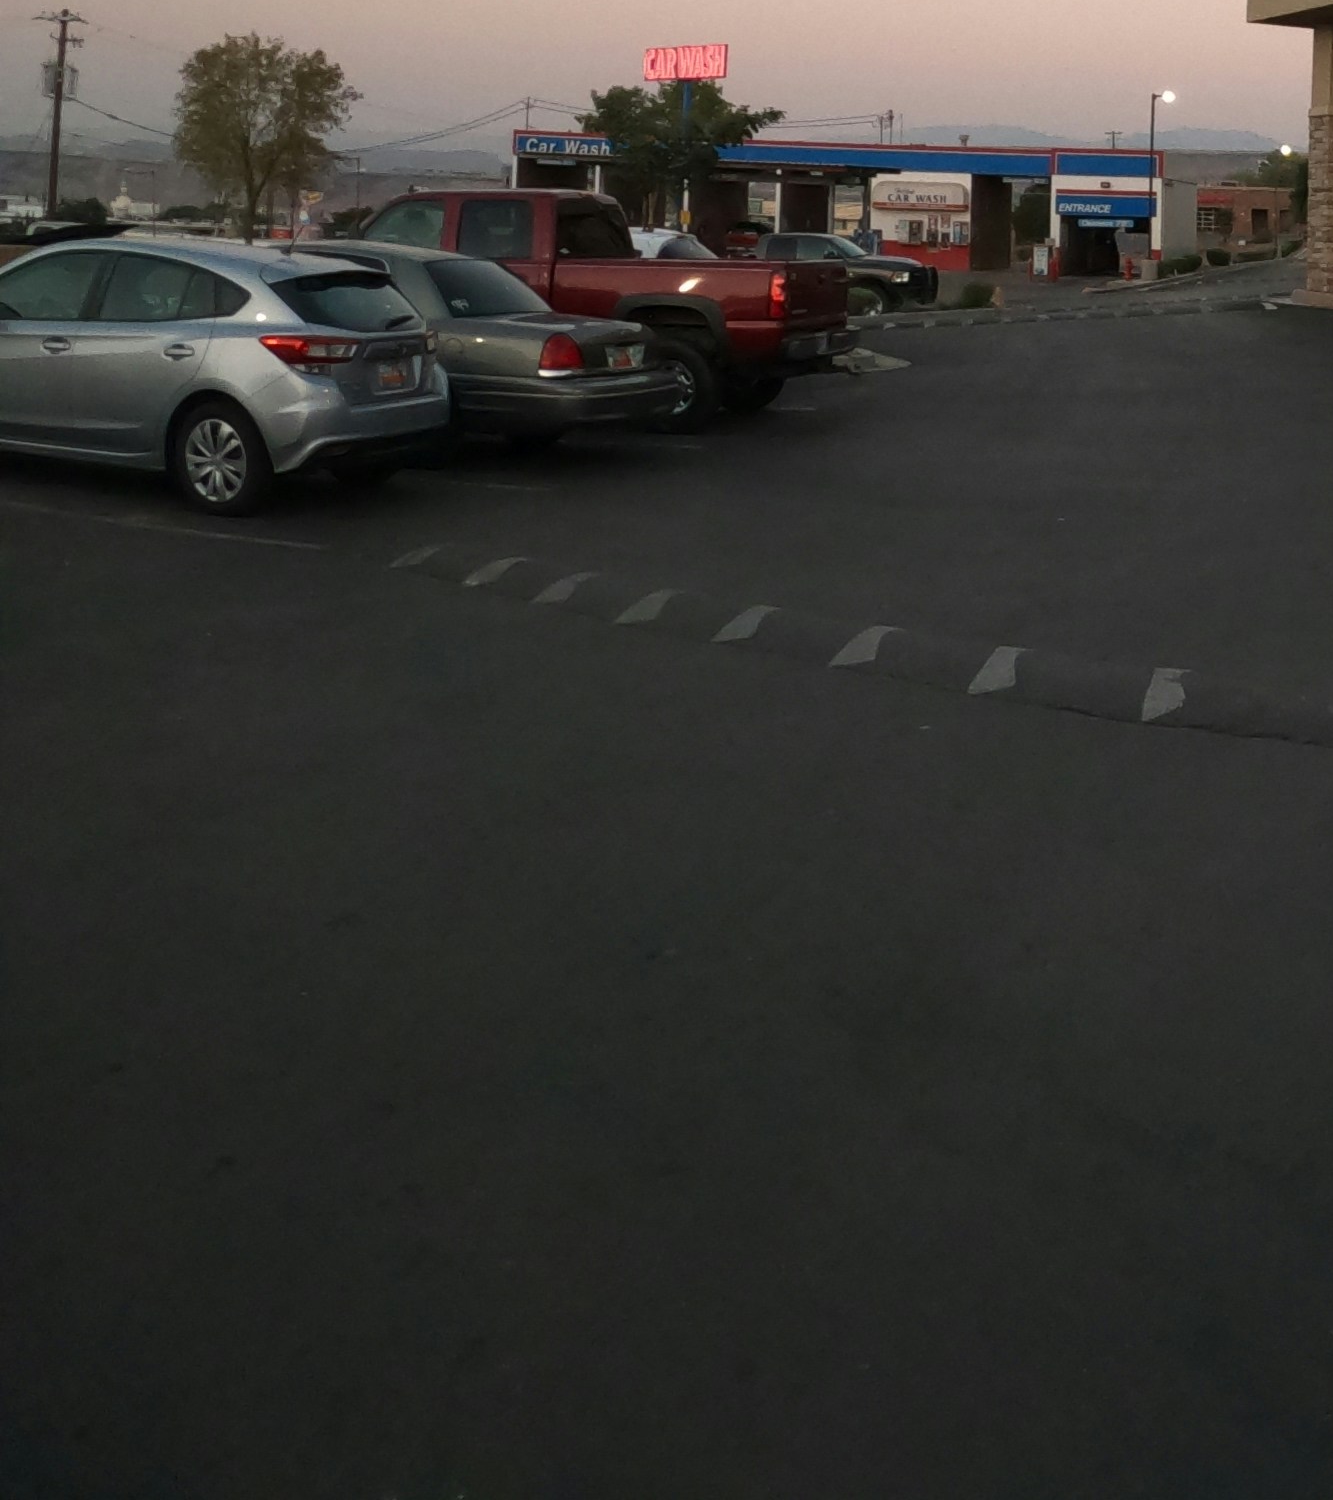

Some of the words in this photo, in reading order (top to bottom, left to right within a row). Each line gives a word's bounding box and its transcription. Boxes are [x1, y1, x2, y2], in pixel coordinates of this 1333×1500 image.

[645, 49, 677, 79] CAR
[678, 45, 726, 79] WASH
[525, 138, 557, 153] Car
[565, 140, 611, 156] Wash
[887, 193, 910, 203] CAR
[915, 194, 947, 204] WASH
[1058, 202, 1112, 214] ENTRANCE
